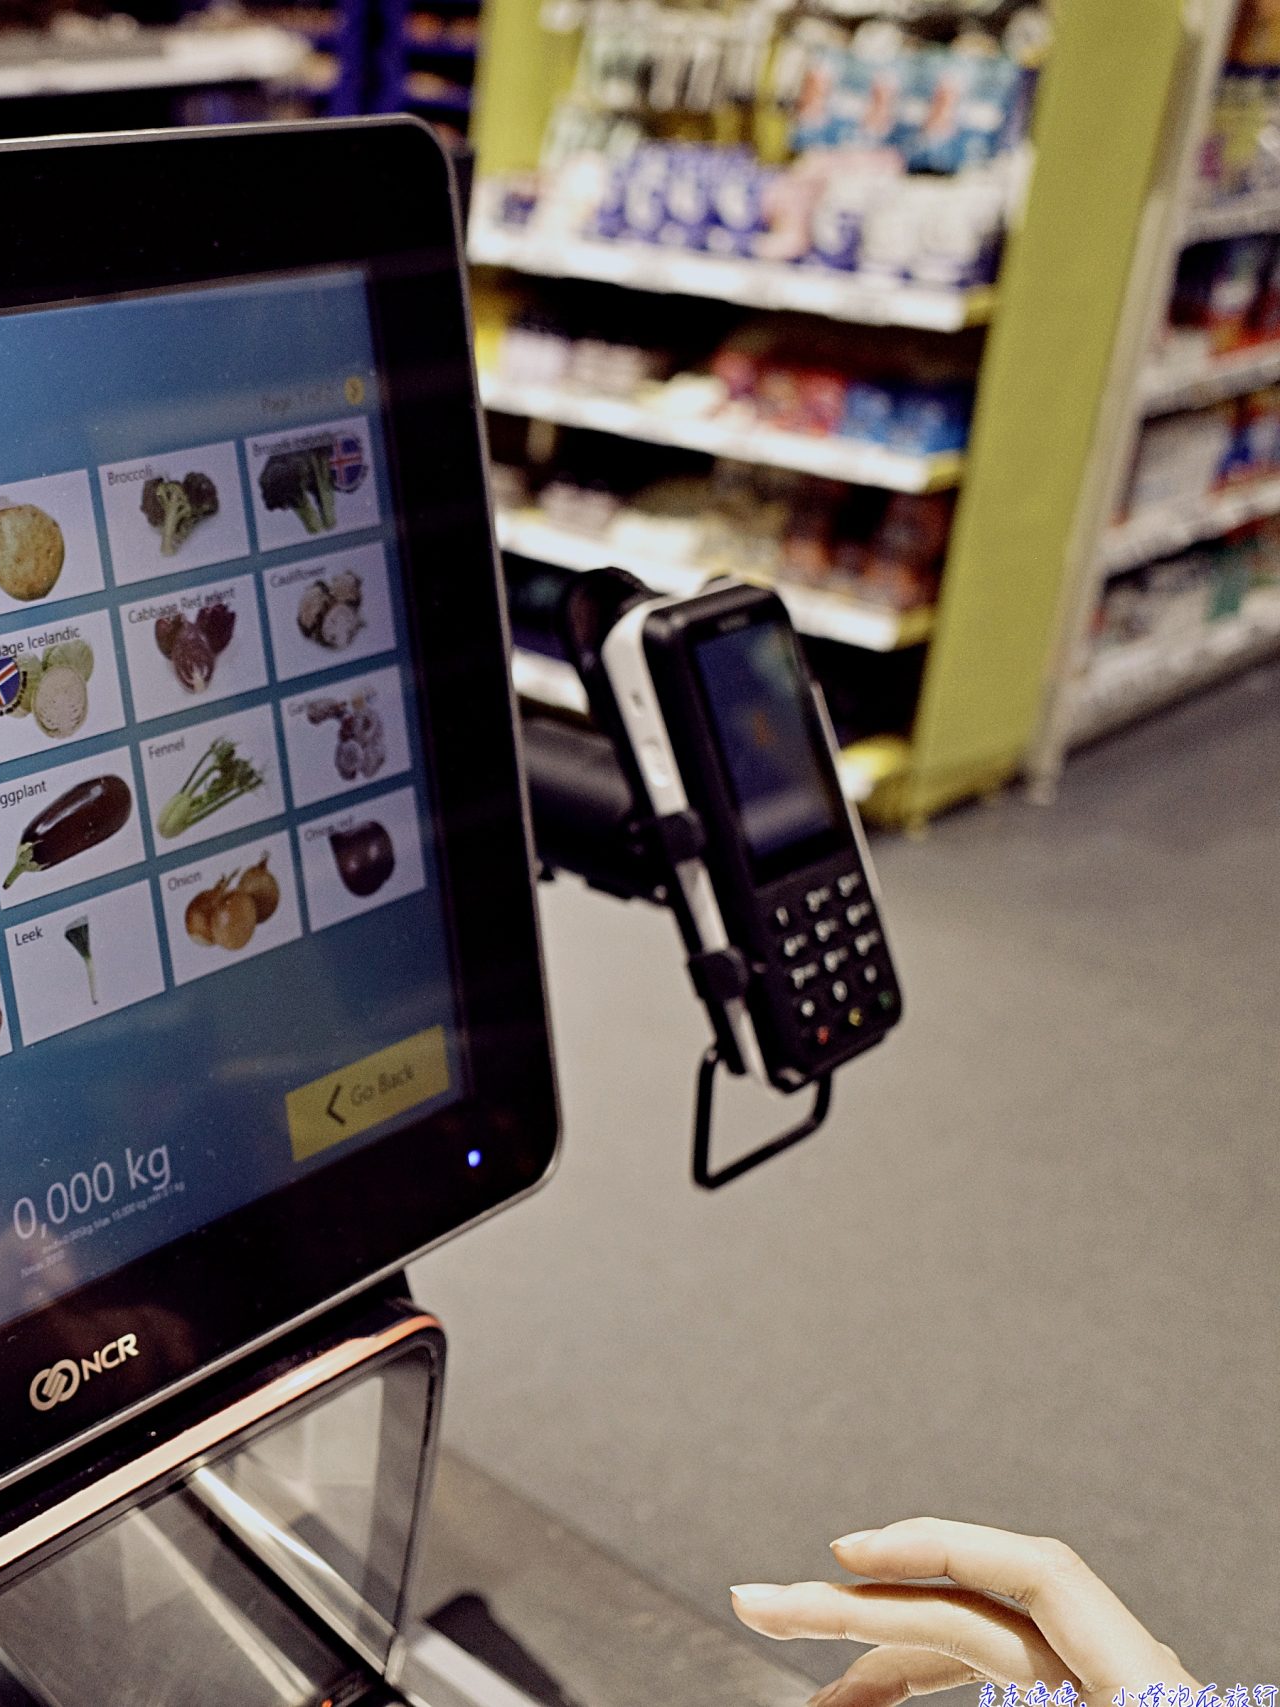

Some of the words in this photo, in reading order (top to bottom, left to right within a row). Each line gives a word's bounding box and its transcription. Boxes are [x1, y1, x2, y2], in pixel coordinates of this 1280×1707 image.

[107, 463, 153, 486] Broccoli
[128, 603, 178, 624] Cabbage
[27, 626, 81, 650] Icelandic
[148, 738, 185, 760] Fennel
[167, 870, 202, 892] Onion
[14, 926, 43, 947] Leek
[350, 1082, 375, 1106] Go
[13, 1161, 115, 1240] 0,000
[125, 1144, 172, 1192] kg
[81, 1333, 140, 1381] NCR
